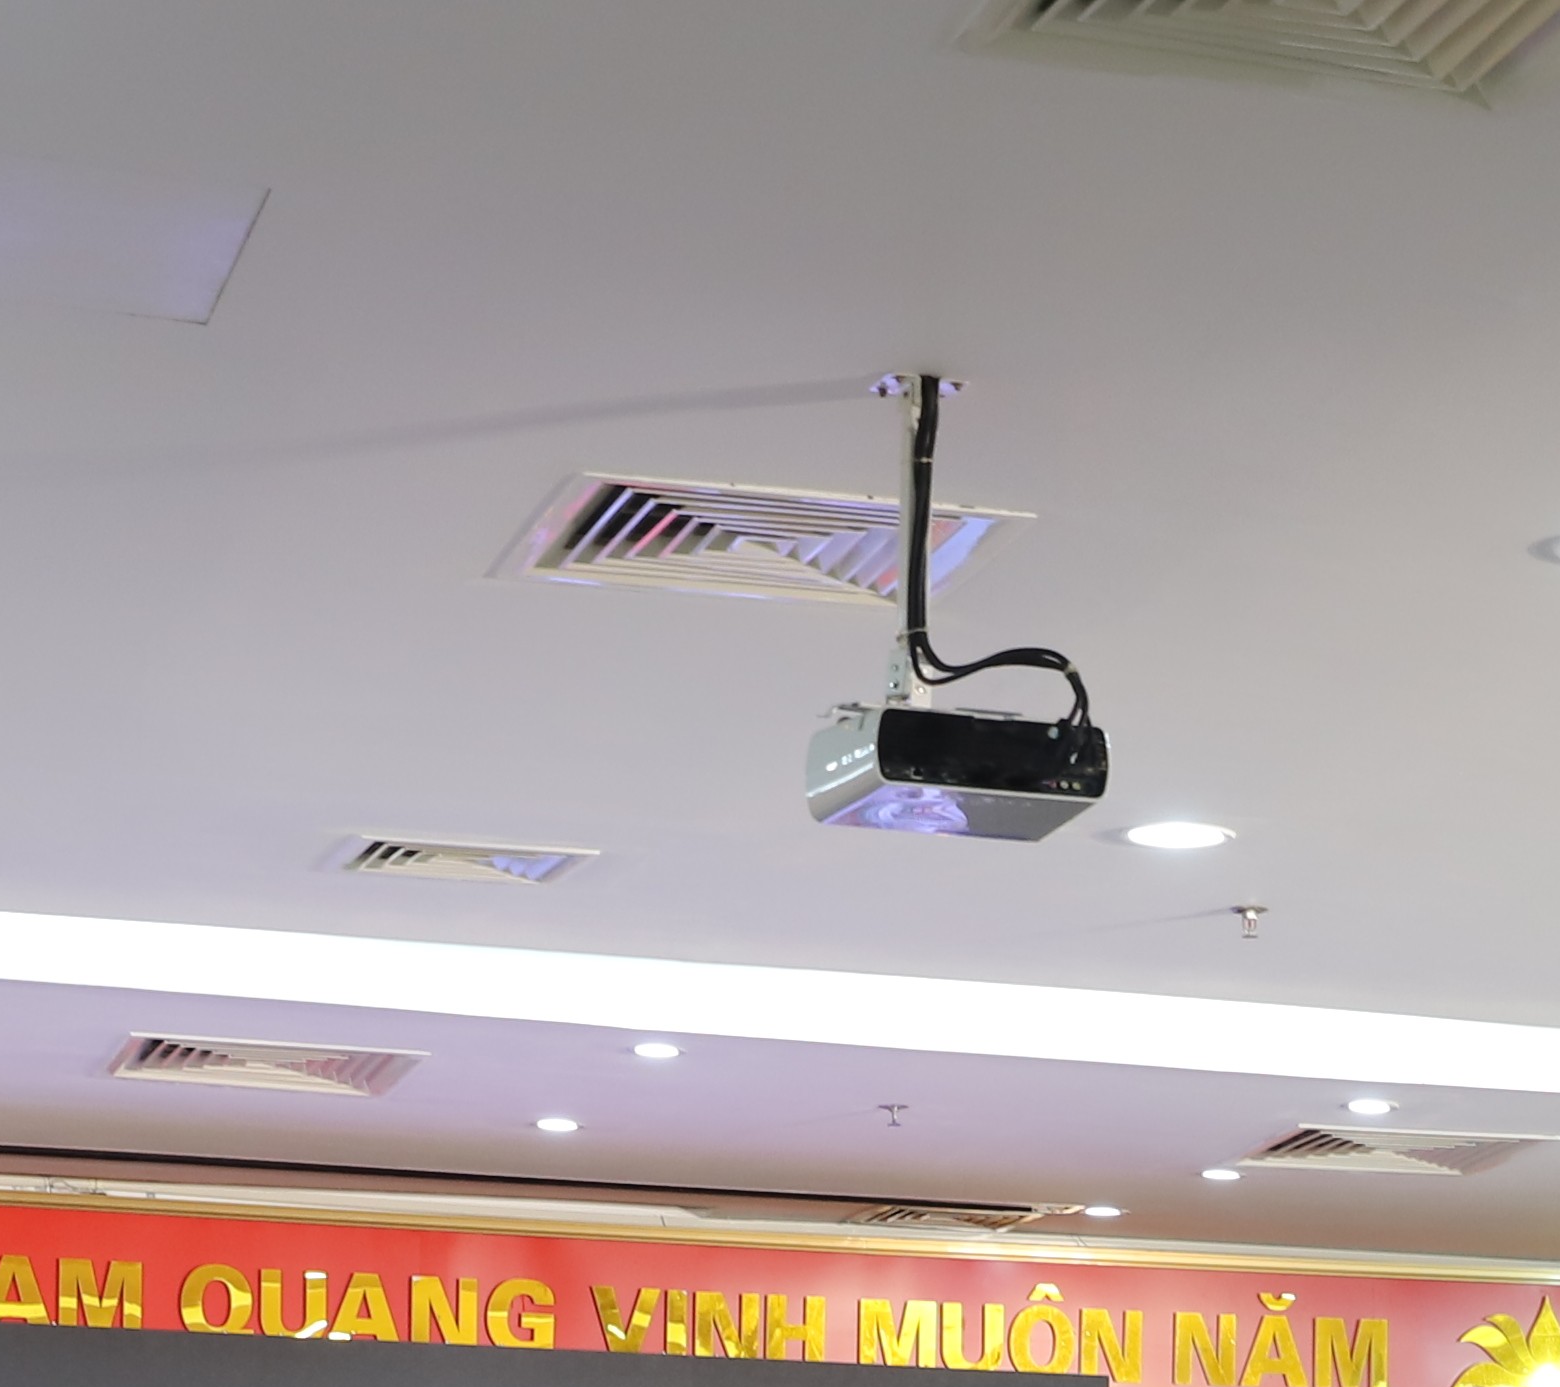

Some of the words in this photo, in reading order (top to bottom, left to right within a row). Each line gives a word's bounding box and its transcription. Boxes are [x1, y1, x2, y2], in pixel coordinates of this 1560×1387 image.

[180, 1263, 556, 1349] QUANG
[590, 1284, 826, 1362] VINH
[858, 1282, 1144, 1384] MUÔN
